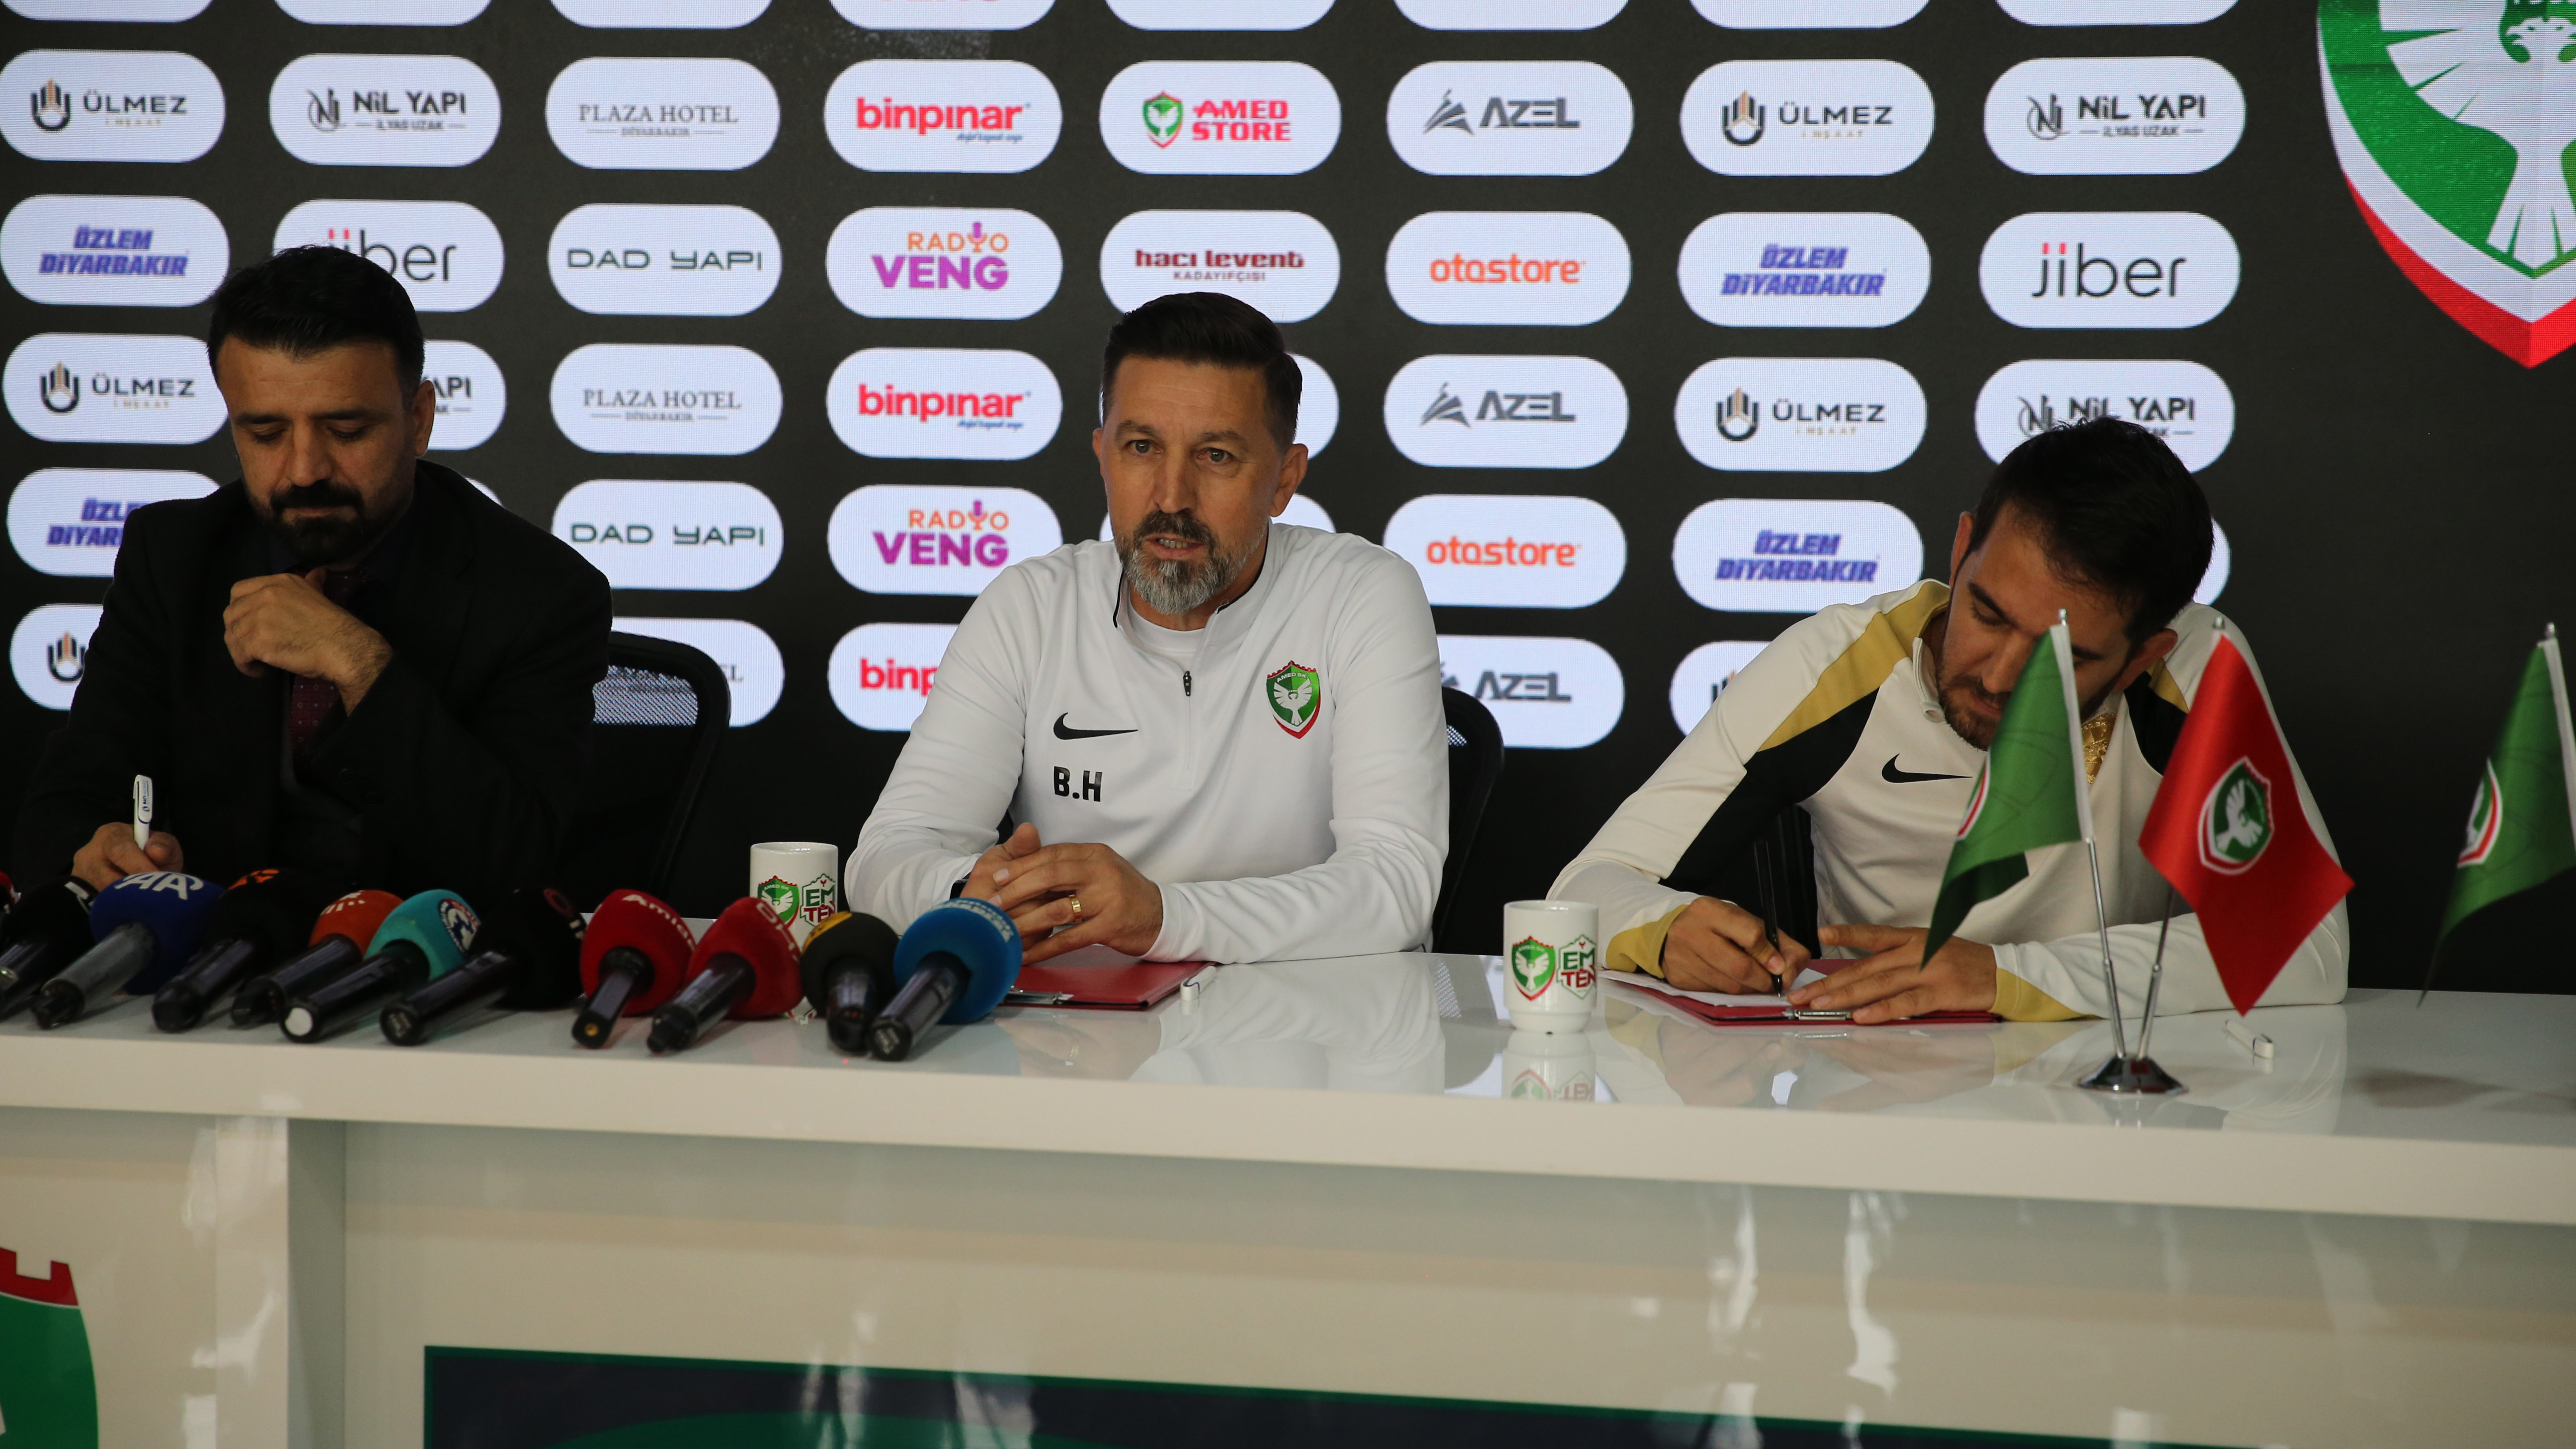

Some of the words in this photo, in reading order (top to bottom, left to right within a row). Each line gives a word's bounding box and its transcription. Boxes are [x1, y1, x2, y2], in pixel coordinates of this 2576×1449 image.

[83, 91, 186, 114] ÜLMEZ
[406, 92, 466, 114] YAPI
[579, 104, 653, 122] PLAZA
[660, 106, 737, 123] HOTEL
[1194, 100, 1288, 119] AMED
[1480, 97, 1580, 128] AZEL
[1779, 102, 1892, 124] ÜLMEZ
[2139, 95, 2205, 120] YAPI
[857, 97, 1023, 134] binpınar
[1193, 122, 1289, 141] STORE
[74, 226, 153, 249] ÖZLEM
[907, 223, 1009, 252] RADYO
[567, 249, 650, 269] DAD
[671, 251, 761, 270] YAPI
[1136, 250, 1197, 267] hacı
[1206, 250, 1303, 268] levent
[1760, 244, 1848, 269] ÖZLEM
[871, 254, 1009, 290] VENG
[2032, 243, 2186, 298] jiber
[92, 374, 194, 397] ÜLMEZ
[584, 389, 656, 407] PLAZA
[664, 391, 740, 408] HOTEL
[859, 384, 1023, 422] binpınar
[1476, 391, 1576, 422] AZEL
[2129, 398, 2194, 421] YAPI
[1772, 400, 1884, 422] ÜLMEZ
[909, 501, 1009, 530] RADYO
[571, 523, 653, 545] DAD
[673, 526, 764, 546] YAPI
[1754, 530, 1841, 556] ÖZLEM
[873, 532, 1009, 566] VENG
[1277, 672, 1296, 683] AMED
[1474, 670, 1572, 701] AZEL
[1053, 766, 1102, 802] B.H
[806, 885, 835, 907] EM
[1563, 948, 1595, 969] EM
